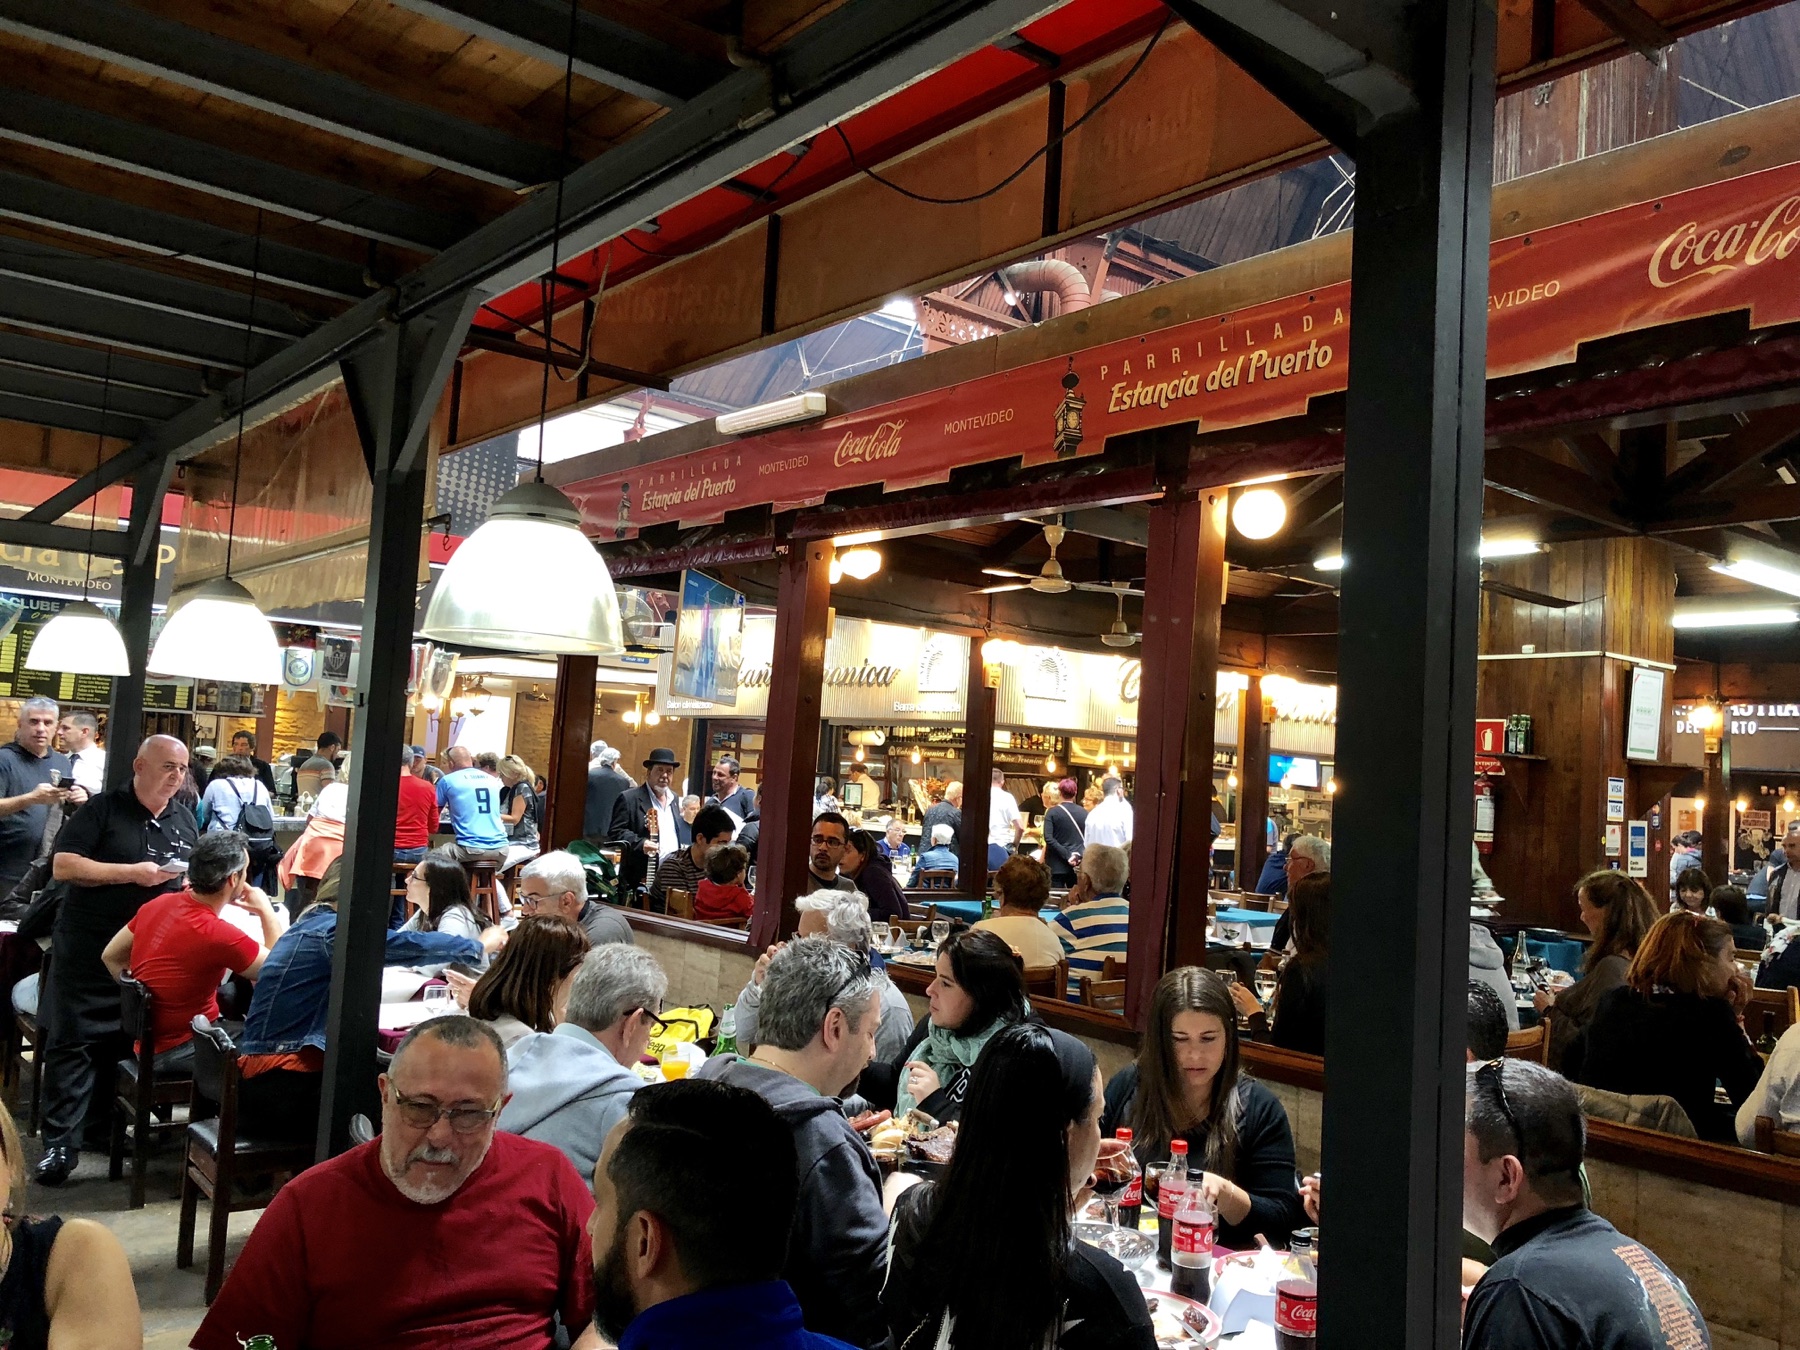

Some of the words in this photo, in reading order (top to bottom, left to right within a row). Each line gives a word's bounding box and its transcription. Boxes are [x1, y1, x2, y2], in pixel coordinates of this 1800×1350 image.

[1100, 307, 1344, 381] PARRILLADA
[1107, 370, 1201, 414] Estancia
[1205, 355, 1245, 392] del
[1247, 339, 1333, 383] Puerto
[943, 408, 1014, 435] MONTEVIDEO
[833, 418, 908, 468] Coca-Cola
[638, 455, 742, 489] PARRILLADA
[758, 455, 809, 476] MONTEVIDEO
[641, 487, 682, 512] Estancia
[683, 482, 699, 501] del
[701, 475, 736, 499] Puerto
[26, 571, 112, 591] MONTEVIDEO
[9, 596, 61, 613] CLUBE
[1676, 720, 1700, 734] DEL
[1730, 720, 1758, 735] RTO
[474, 787, 492, 815] 9
[1610, 784, 1622, 793] VISA
[1610, 805, 1622, 814] VISA
